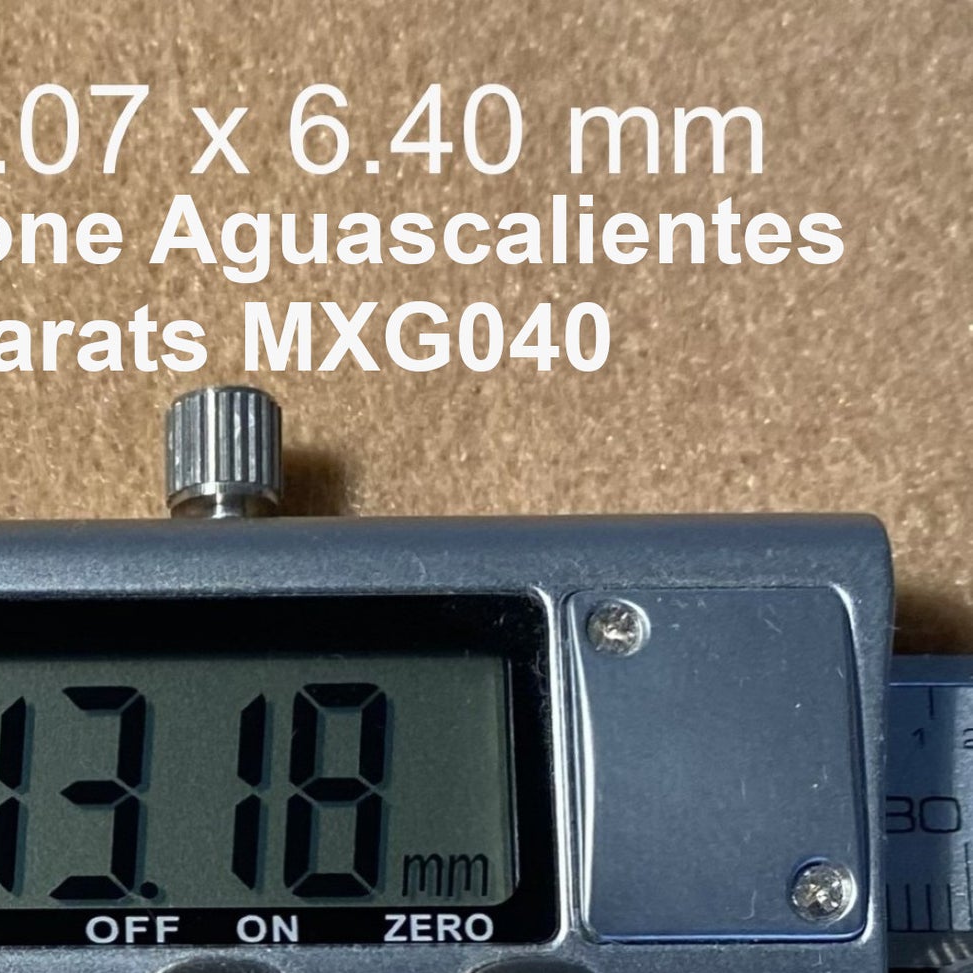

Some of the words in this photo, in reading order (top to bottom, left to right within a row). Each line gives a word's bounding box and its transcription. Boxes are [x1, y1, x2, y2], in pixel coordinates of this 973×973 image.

[401, 850, 491, 898] mm
[85, 915, 180, 944] OFF
[236, 914, 299, 944] ON
[383, 912, 494, 942] ZERO
